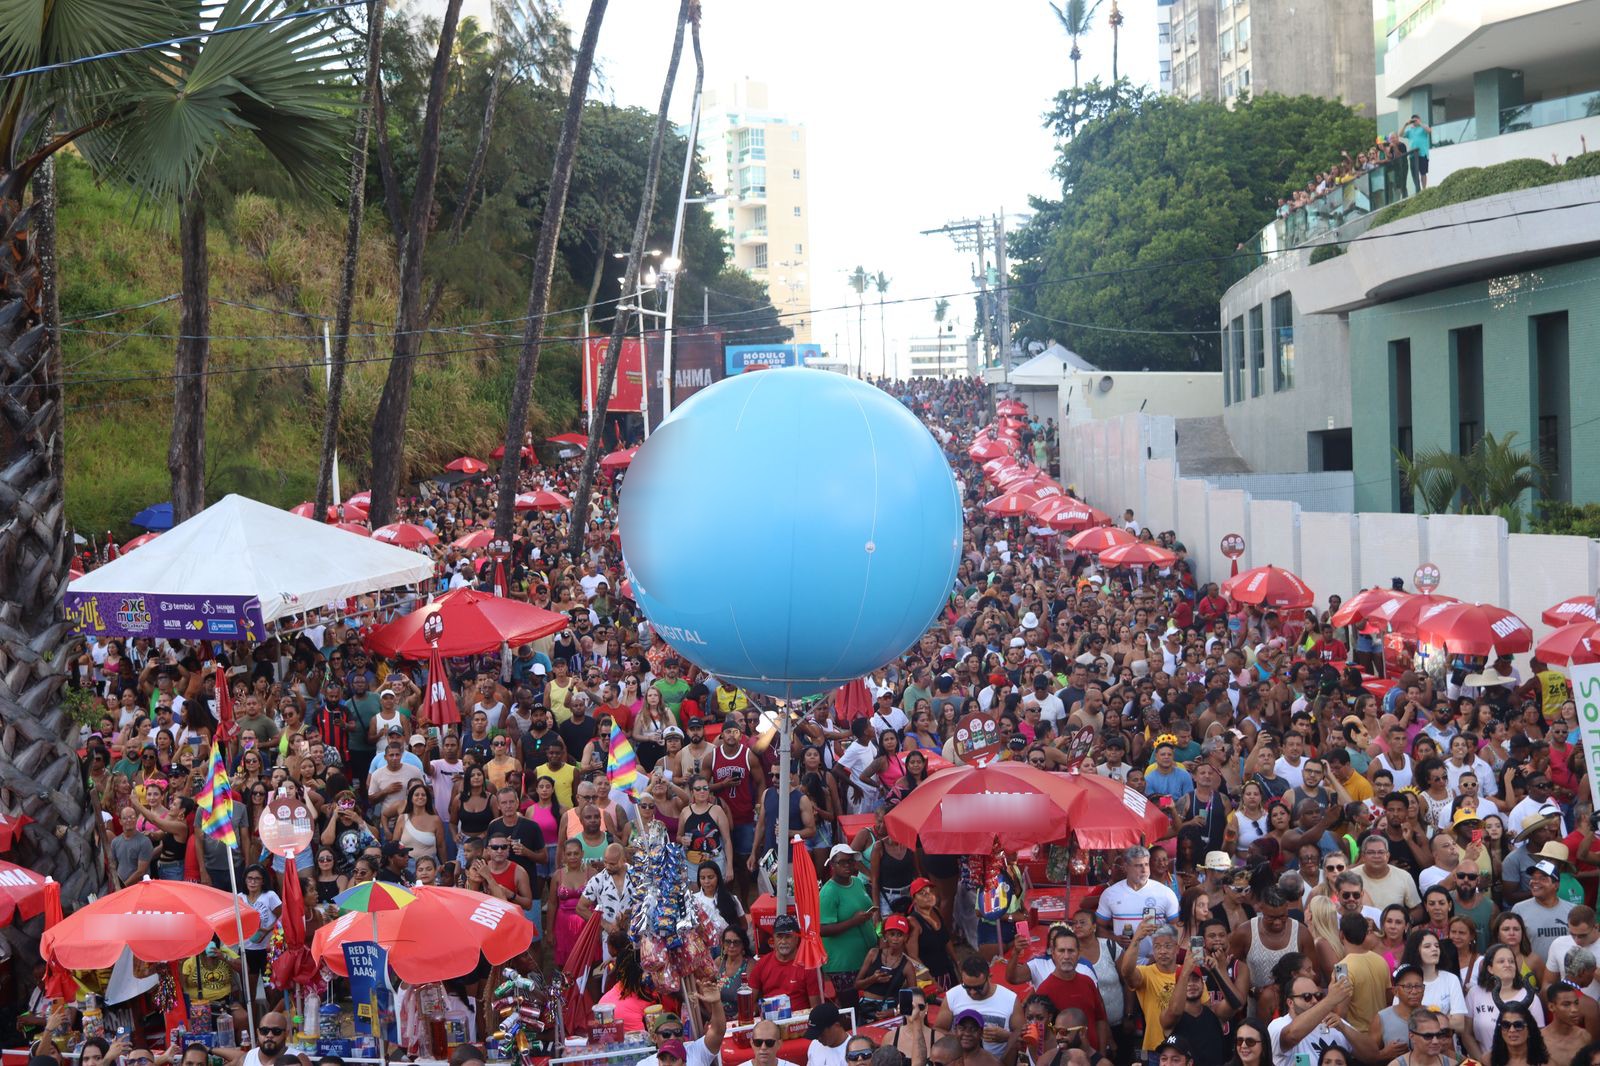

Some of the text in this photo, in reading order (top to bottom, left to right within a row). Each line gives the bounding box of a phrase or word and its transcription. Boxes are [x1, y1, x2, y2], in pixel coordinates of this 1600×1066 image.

[743, 351, 786, 359] MÓDULO
[656, 368, 713, 388] BAHMA
[173, 602, 196, 611] tembici
[348, 945, 365, 955] RED
[351, 956, 361, 965] TE
[1475, 1004, 1495, 1014] NEW
[592, 1027, 617, 1035] BEATS
